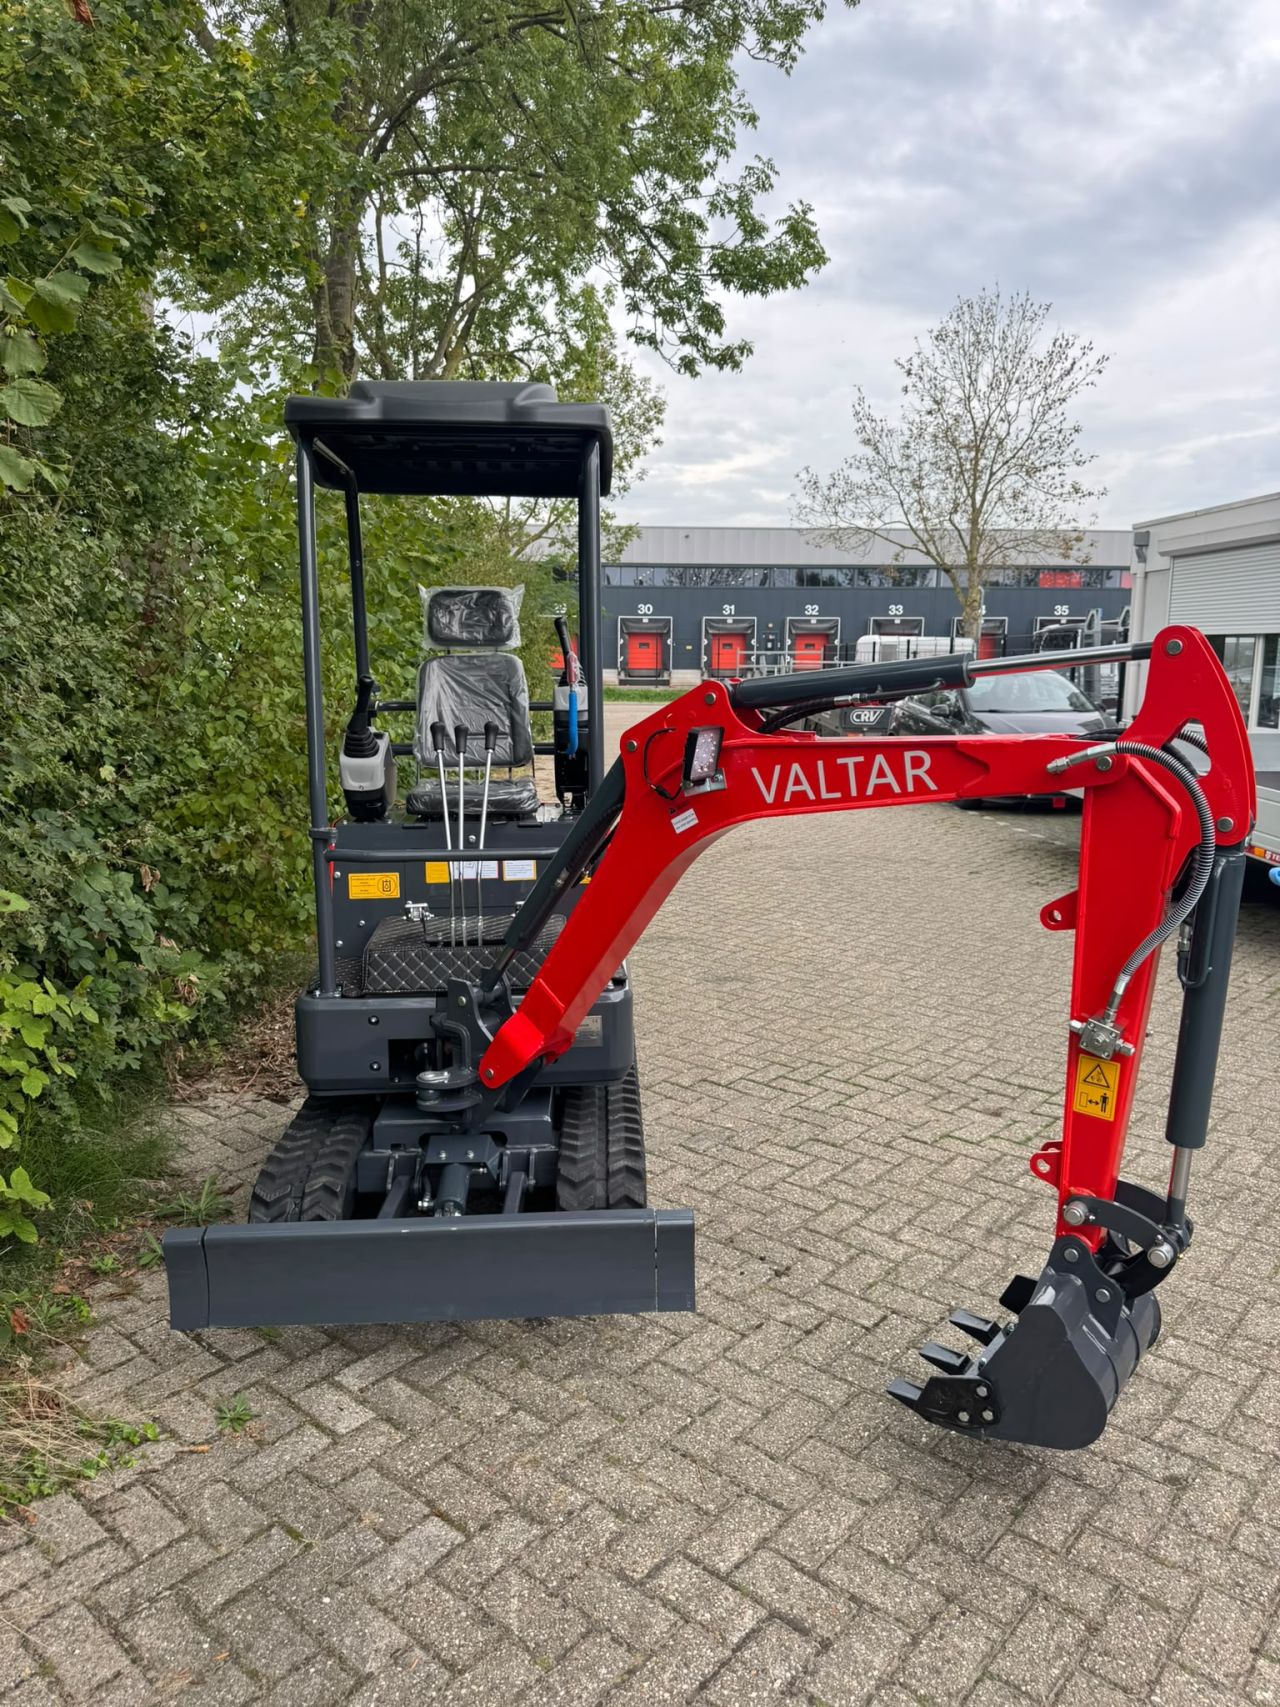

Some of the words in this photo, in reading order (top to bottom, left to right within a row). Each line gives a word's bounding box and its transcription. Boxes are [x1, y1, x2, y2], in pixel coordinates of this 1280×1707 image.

[637, 604, 653, 615] 30
[722, 604, 735, 615] 31
[804, 604, 819, 615] 32
[888, 604, 904, 615] 33
[1053, 605, 1069, 616] 35
[853, 711, 880, 722] CRV
[751, 750, 938, 804] VALTAR
